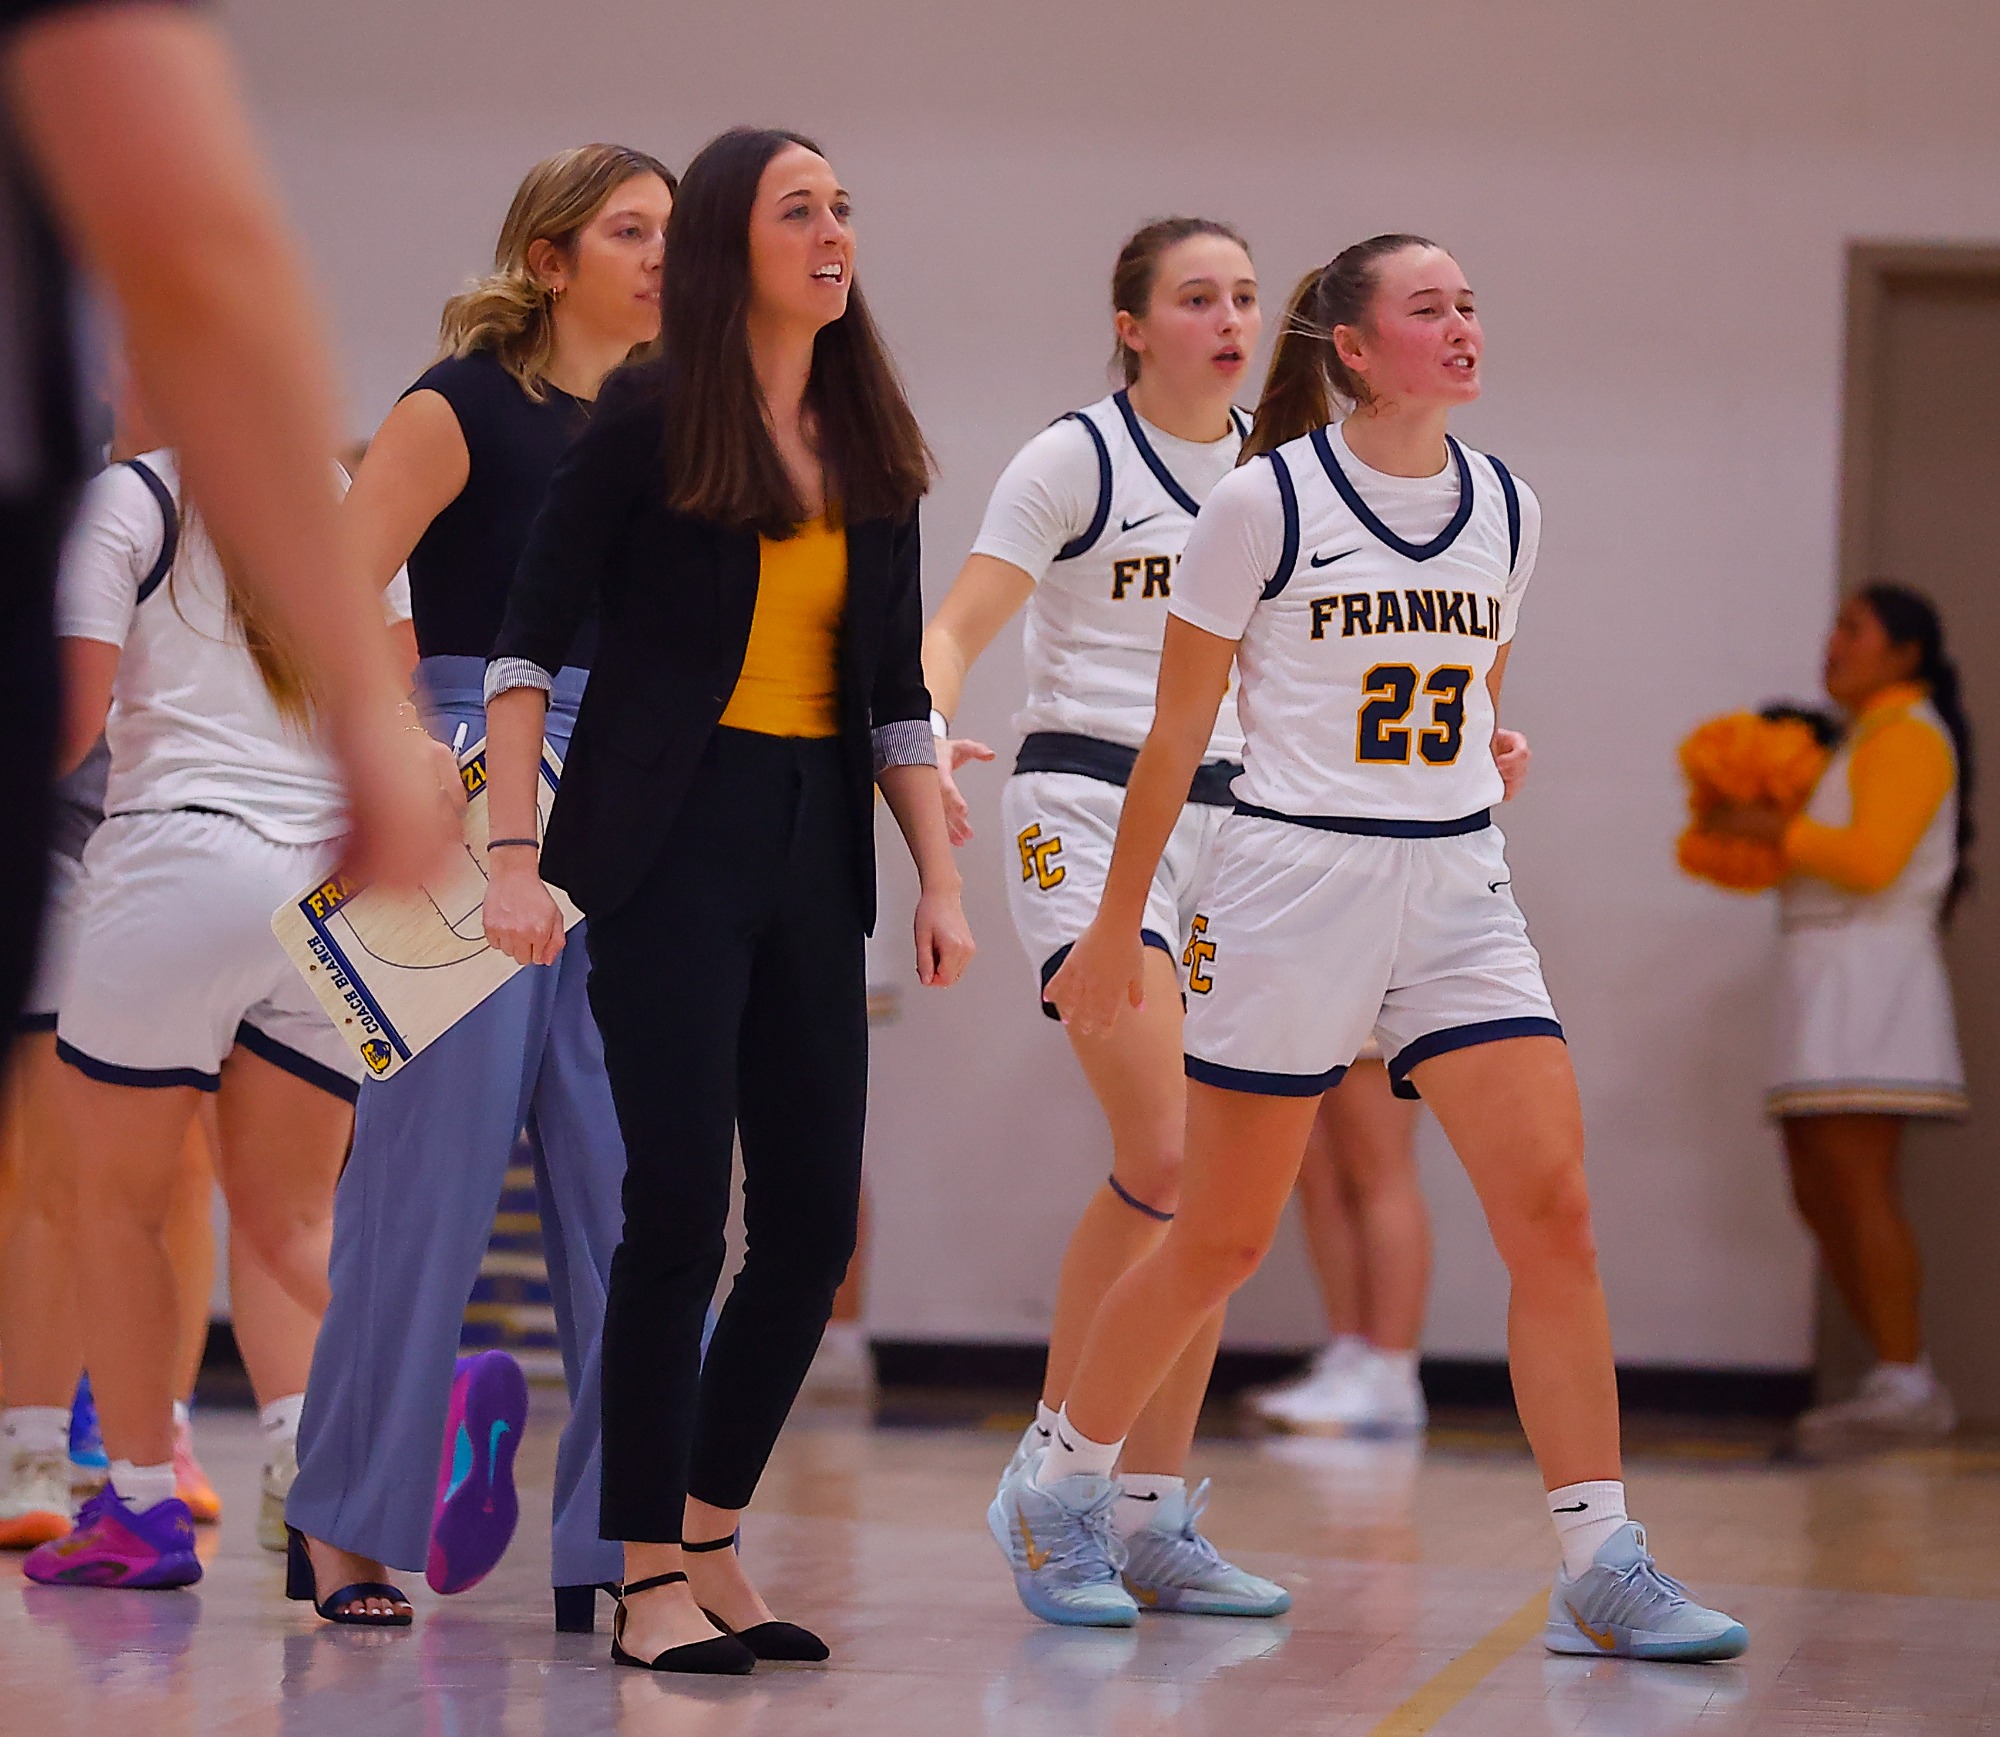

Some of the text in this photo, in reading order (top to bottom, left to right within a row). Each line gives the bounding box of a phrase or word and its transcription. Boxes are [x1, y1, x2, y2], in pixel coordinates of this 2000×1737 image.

[1355, 662, 1473, 766] 23
[1017, 823, 1066, 890] FC
[306, 935, 350, 990] BLANCH
[343, 990, 379, 1034] COACH
